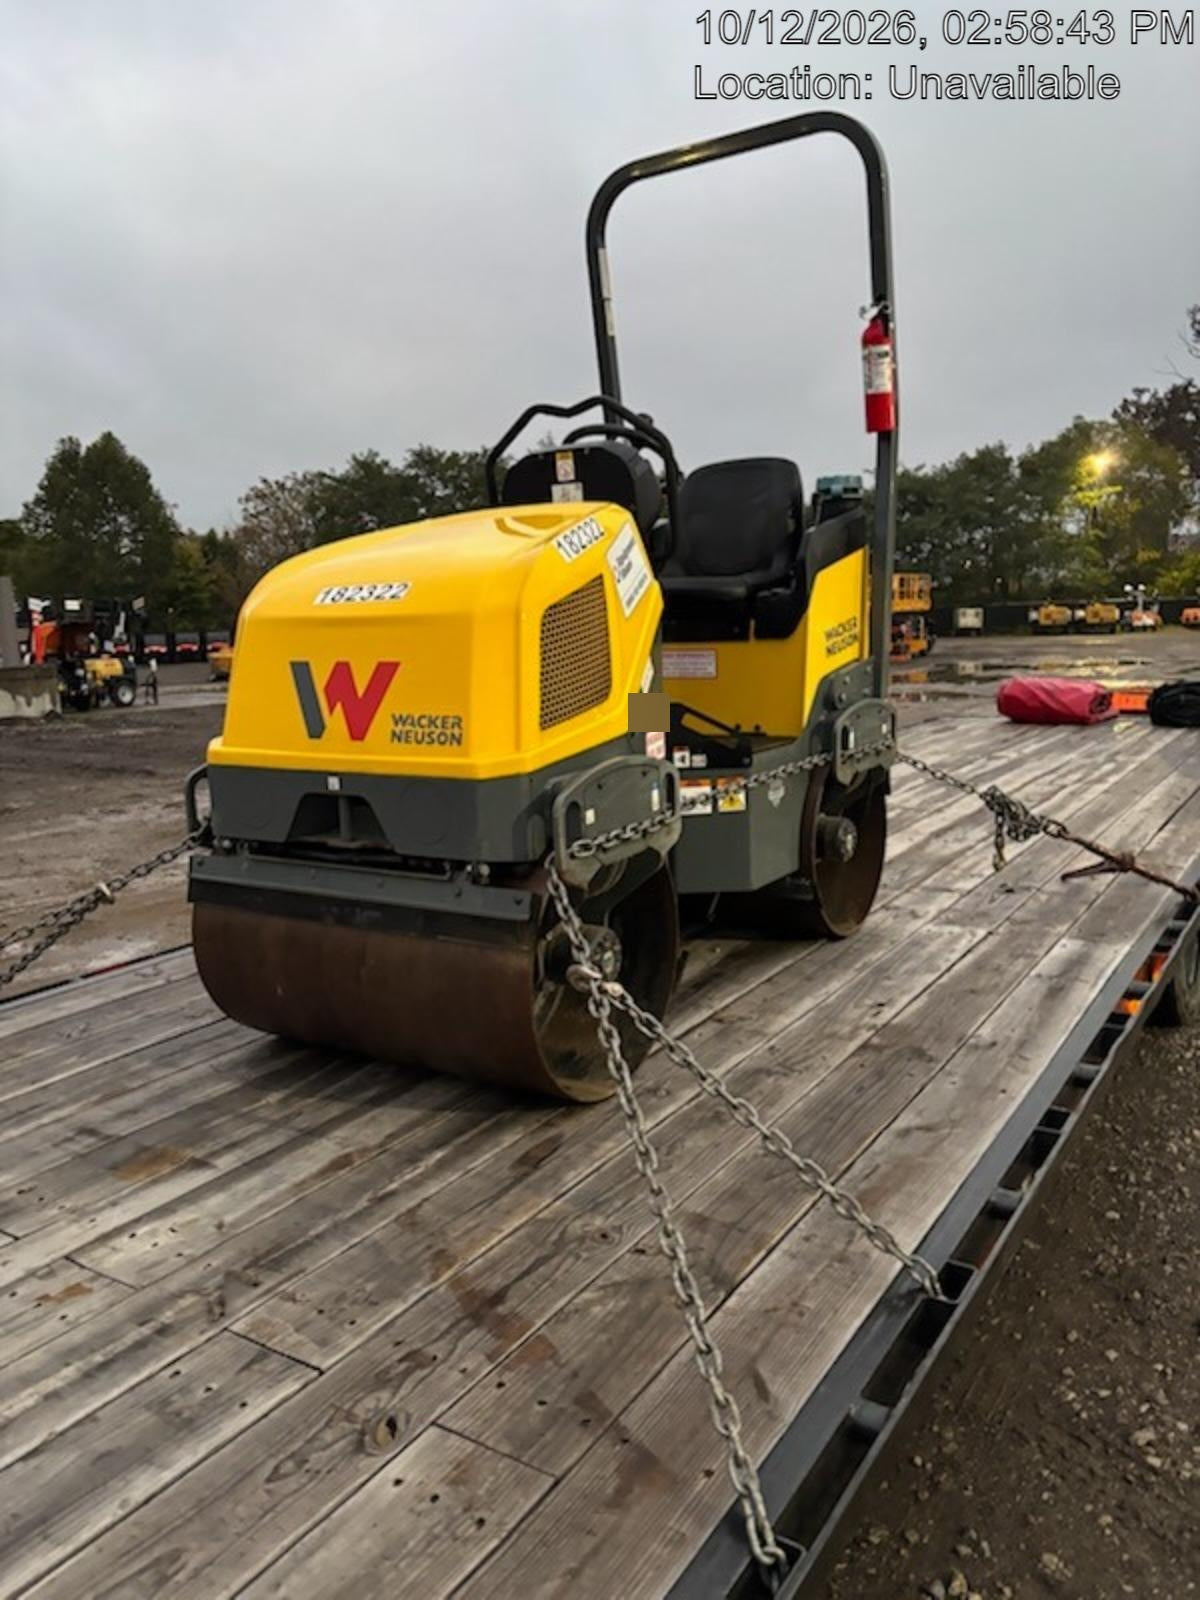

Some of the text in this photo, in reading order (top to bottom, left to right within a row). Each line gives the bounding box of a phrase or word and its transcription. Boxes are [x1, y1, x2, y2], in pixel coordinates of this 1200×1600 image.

[319, 582, 410, 604] 182322
[825, 617, 858, 641] WACKER
[825, 634, 859, 658] NEUSON
[391, 713, 463, 730] WACKER
[390, 729, 463, 747] NEUSON
